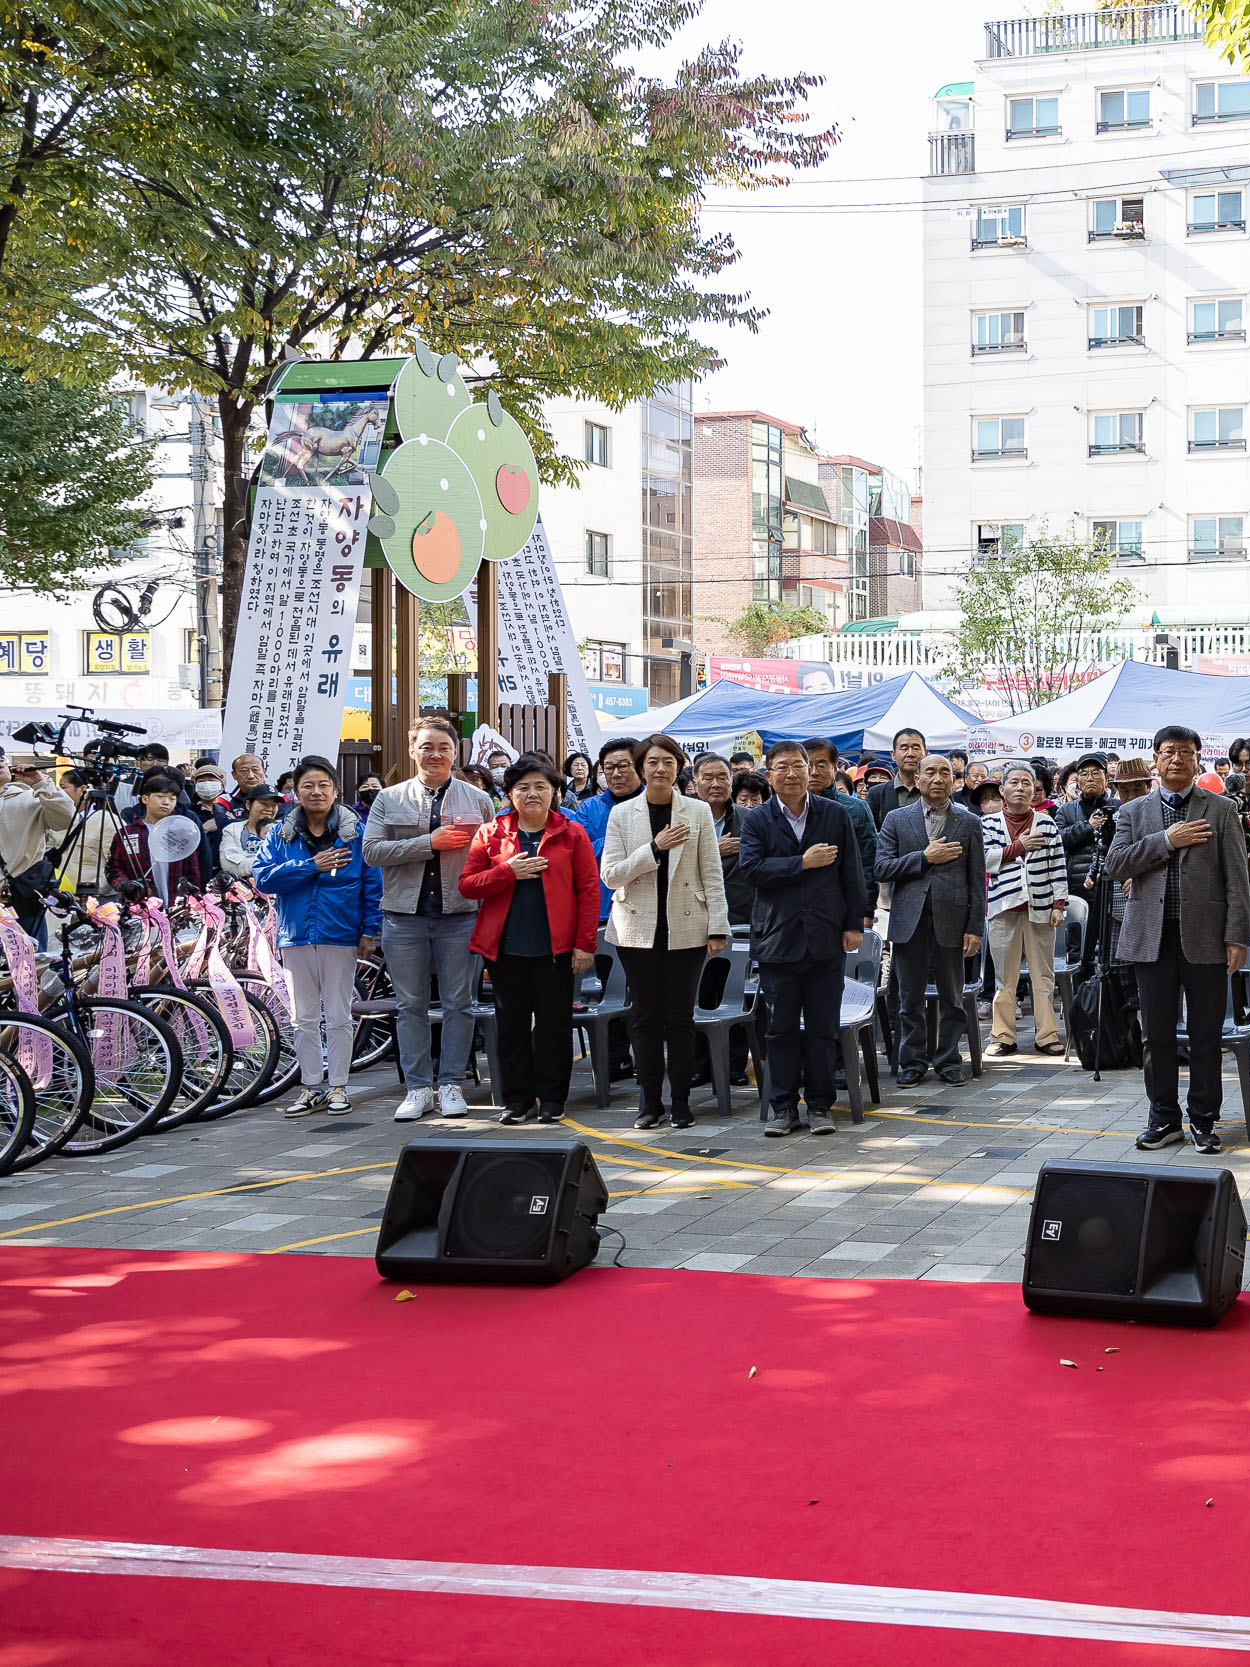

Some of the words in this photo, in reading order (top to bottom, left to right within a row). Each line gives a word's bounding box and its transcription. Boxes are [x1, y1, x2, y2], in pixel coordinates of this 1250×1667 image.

[254, 499, 272, 559] 자마장이라
[273, 498, 287, 533] 난다고
[318, 498, 332, 535] 자양동
[268, 567, 278, 577] 이
[281, 542, 296, 590] 국가에서
[294, 542, 311, 602] 자양동으로
[330, 496, 364, 615] 자양동의
[261, 582, 276, 630] 지역에서
[279, 594, 290, 606] 말
[306, 579, 322, 627] 조선시대
[94, 638, 146, 660] 생활
[258, 635, 270, 660] 암말
[285, 648, 298, 672] 데서
[300, 633, 314, 682] 이곳에서
[256, 664, 266, 675] 즉
[318, 635, 343, 698] 유래
[278, 676, 294, 747] 유래되었다.
[295, 686, 308, 724] 암말을
[262, 706, 274, 744] 기르면
[292, 728, 303, 752] 길러
[1024, 736, 1029, 746] 3
[1037, 736, 1063, 748] 할로윈
